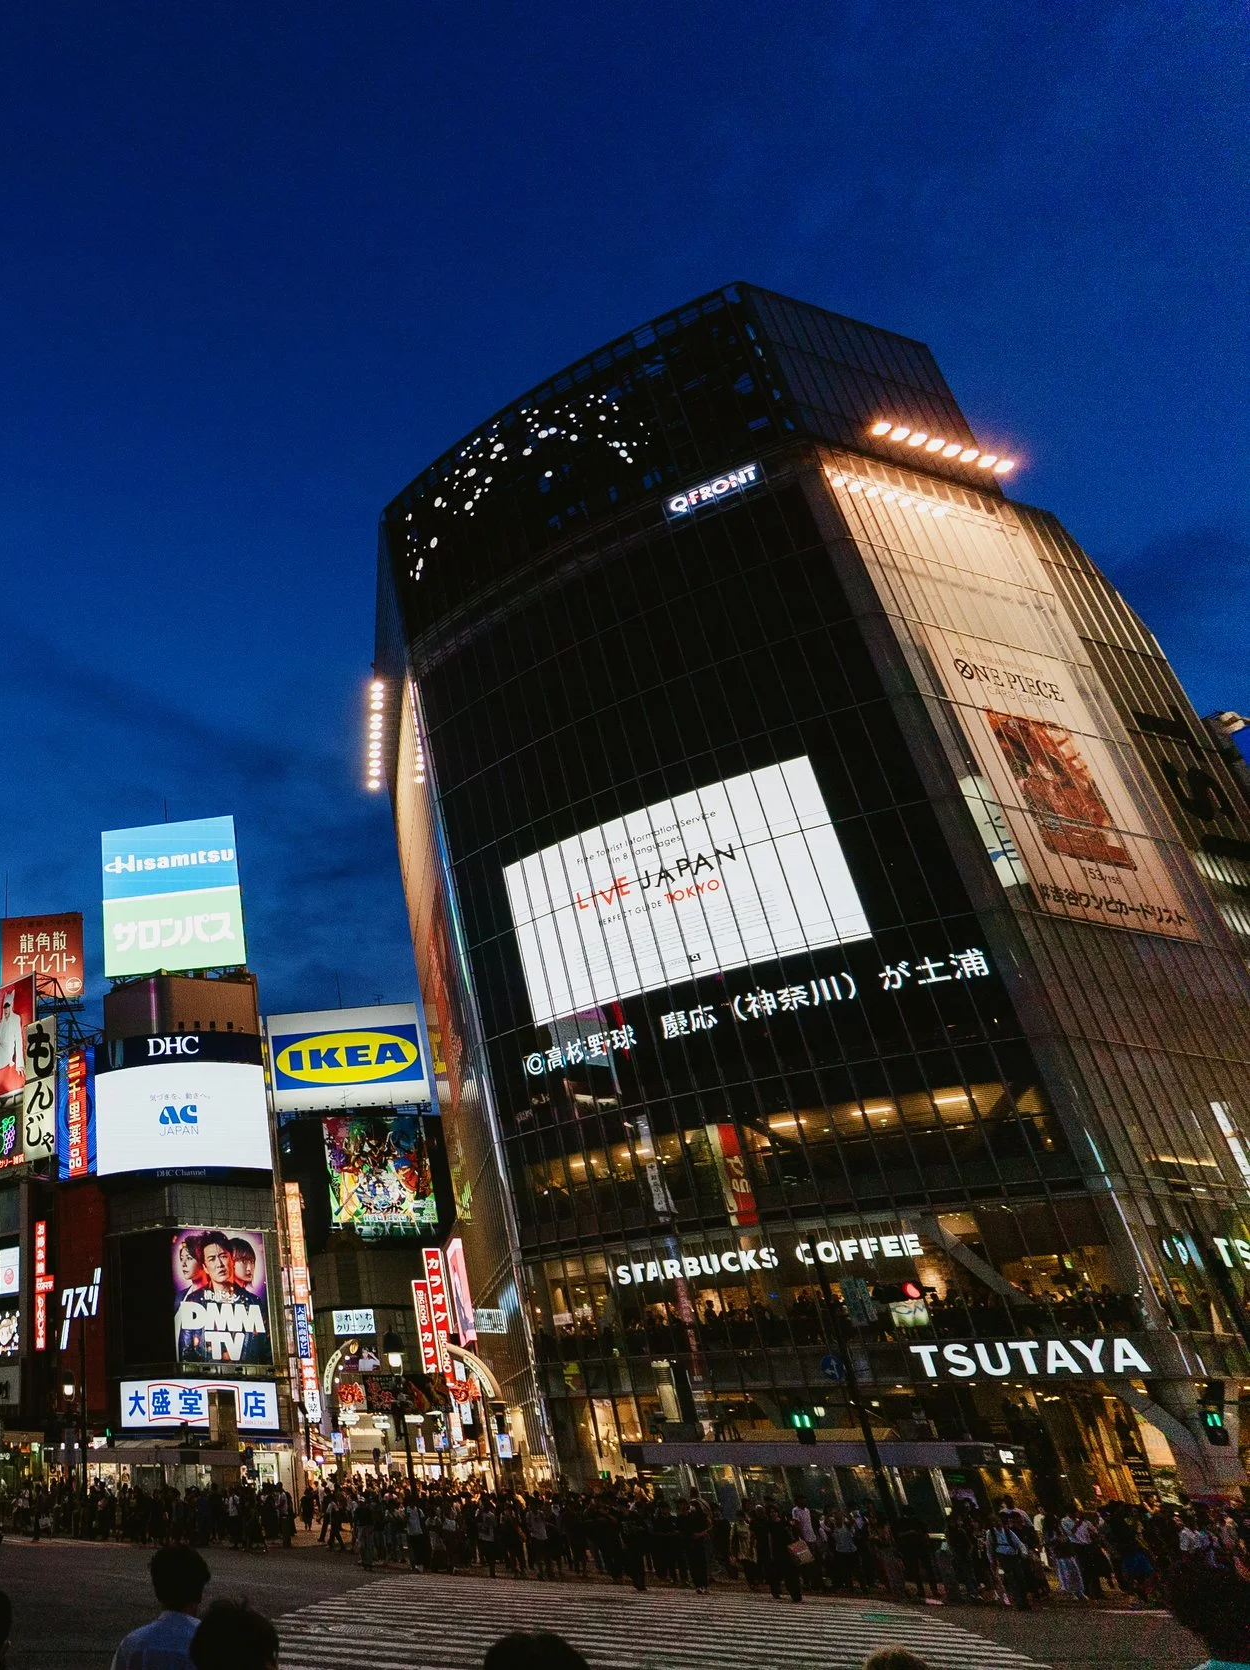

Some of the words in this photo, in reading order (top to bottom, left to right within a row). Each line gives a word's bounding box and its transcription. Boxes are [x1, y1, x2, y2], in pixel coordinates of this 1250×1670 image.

[670, 464, 758, 514] QFRONT
[953, 658, 1004, 687] ONE
[1003, 671, 1065, 703] PIECE
[577, 854, 595, 865] Free
[596, 842, 624, 857] Tourist
[625, 823, 679, 847] Information
[680, 810, 717, 828] Service
[104, 848, 234, 874] Hisamitsu
[577, 876, 631, 910] LIVE
[641, 843, 737, 890] JAPAN
[599, 910, 634, 927] PERFECT
[635, 900, 662, 915] GUIDE
[664, 879, 720, 905] TOKYO
[19, 930, 68, 954] 龍角散
[112, 911, 236, 952] サロンパス
[12, 952, 77, 975] ダイレクト
[147, 1035, 200, 1057] DHC
[288, 1042, 409, 1073] IKEA
[26, 1024, 55, 1153] もんじゃ
[68, 1055, 83, 1170] 三千里薬品
[159, 1104, 198, 1125] AC
[159, 1124, 200, 1137] JAPAN
[156, 1169, 174, 1178] DHC
[175, 1168, 207, 1178] Channel
[616, 1246, 778, 1285] STARBUCKS
[795, 1233, 923, 1264] COFFEE
[427, 1258, 448, 1323] カラオケ
[60, 1266, 102, 1350] クスリ
[179, 1301, 266, 1333] DMM
[344, 1312, 373, 1321] れいわ
[336, 1324, 374, 1333] クリニック
[204, 1331, 245, 1360] TV
[910, 1338, 1152, 1378] TSUTAYA
[128, 1388, 266, 1418] 大盛堂店
